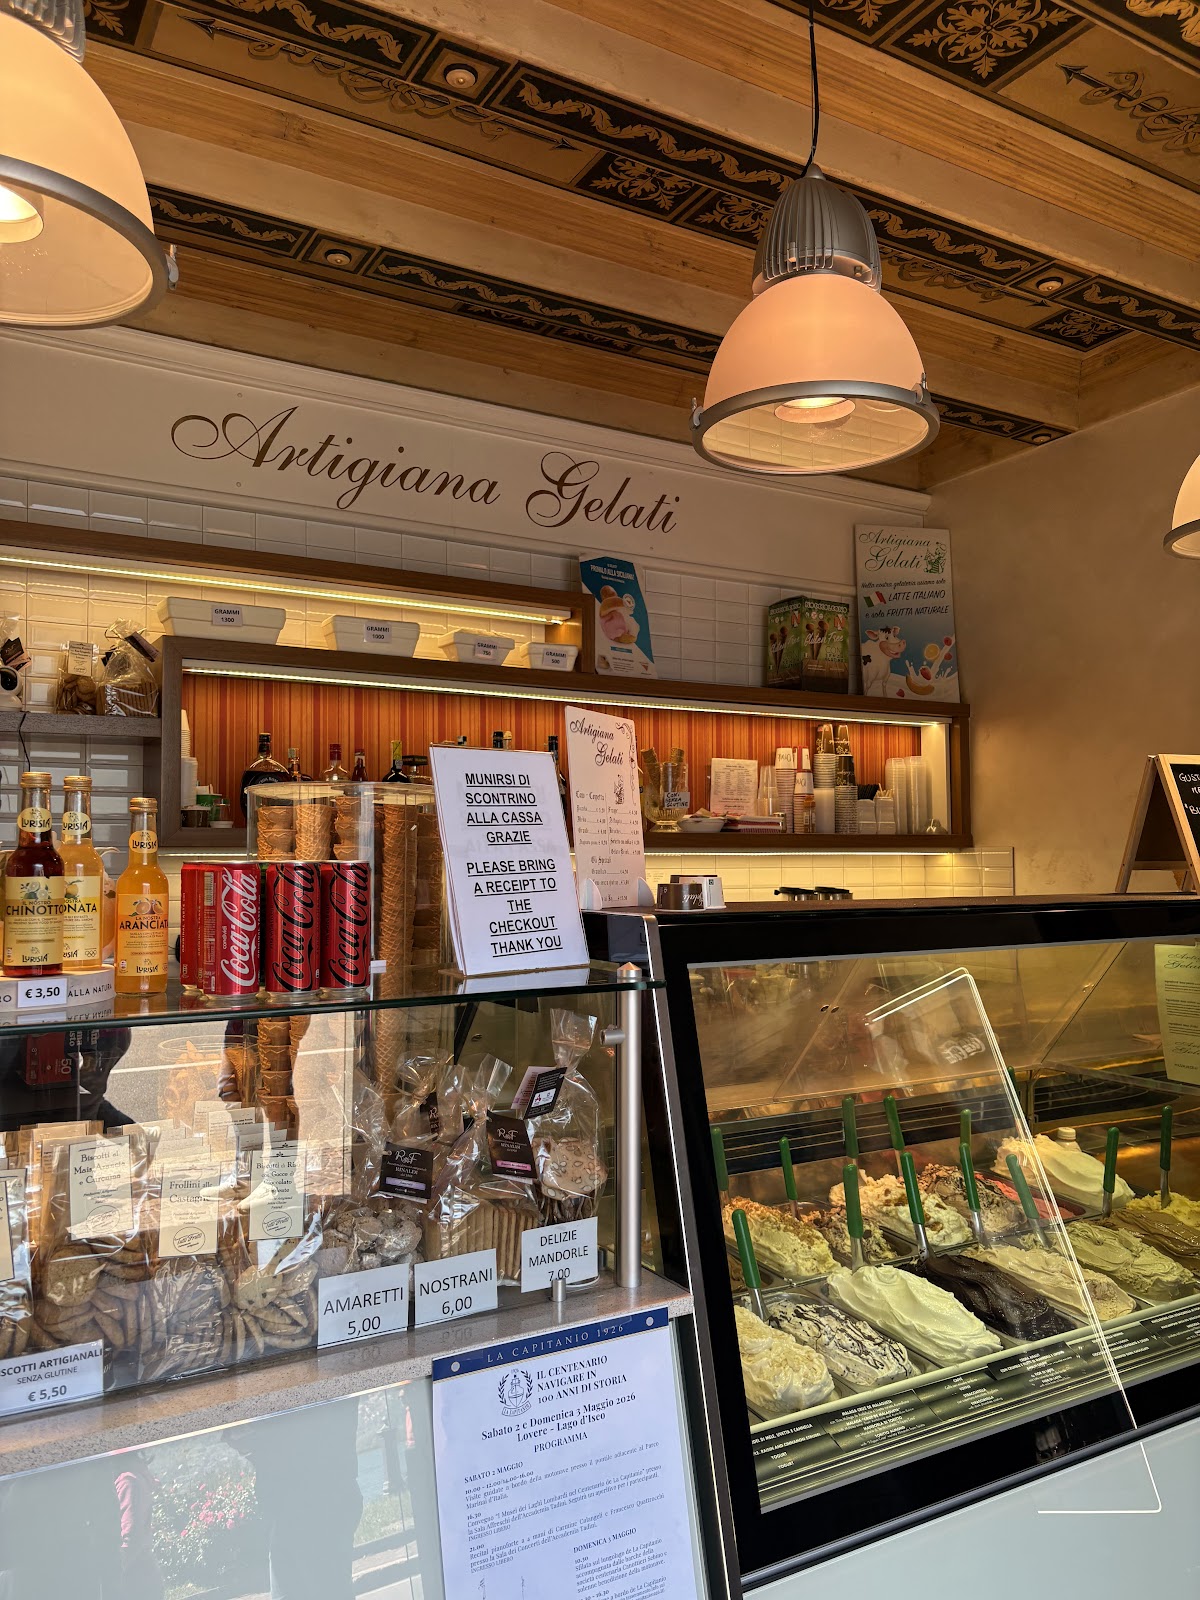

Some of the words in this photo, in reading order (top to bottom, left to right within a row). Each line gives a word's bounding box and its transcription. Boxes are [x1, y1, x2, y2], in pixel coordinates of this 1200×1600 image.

[170, 405, 501, 510] Artigiana
[525, 451, 680, 534] Gelati
[859, 529, 933, 552] Artigiana
[865, 545, 923, 572] Gelati
[889, 591, 912, 603] LATTE
[913, 589, 946, 601] ITALIANO
[214, 608, 240, 617] GRAMMI
[220, 616, 235, 624] 1300
[871, 609, 885, 618] solo
[887, 607, 913, 617] FRUTTA
[915, 605, 949, 617] NATURALE
[366, 625, 390, 634] GRAMMI
[371, 633, 385, 641] 1000
[477, 642, 498, 650] GRAMMI
[545, 651, 567, 659] GRAMMI
[569, 717, 615, 744] Artigiana
[594, 741, 624, 767] Gelati
[465, 773, 516, 787] MUNIRSI
[518, 774, 531, 787] DI
[465, 793, 537, 806] SCONTRINO
[21, 817, 51, 829] LURISIA
[467, 811, 500, 825] ALLA
[501, 811, 543, 824] CASSA
[132, 840, 157, 850] LURISIA
[486, 830, 533, 845] GRAZIE
[466, 861, 515, 876] PLEASE
[518, 858, 557, 873] BRING
[474, 881, 484, 895] A
[486, 879, 537, 894] RECEIPT
[538, 877, 557, 891] TO
[6, 903, 64, 916] CHINOTTO
[507, 898, 533, 913] THE
[119, 919, 169, 930] ARANCIAT
[489, 916, 556, 935] CHECKOUT
[490, 937, 536, 956] THANK
[536, 935, 563, 951] YOU
[22, 954, 48, 964] LURISIA
[25, 988, 33, 999] €
[35, 986, 60, 999] 3,50
[81, 1152, 110, 1163] Biscotti
[85, 1173, 121, 1184] Curcuma
[169, 1180, 201, 1189] Frollini
[540, 1229, 578, 1247] DELIZIE
[528, 1245, 589, 1268] MANDORLE
[419, 1267, 494, 1297] NOSTRANI
[323, 1287, 404, 1316] AMARETTI
[442, 1295, 473, 1317] 6,00
[347, 1315, 382, 1337] 5,00
[487, 1353, 504, 1363] LA
[512, 1331, 589, 1357] CAPITANIO
[597, 1325, 624, 1338] 1926
[0, 1360, 37, 1378] SCOTTI
[37, 1348, 103, 1374] ARTIGIANALI
[536, 1370, 548, 1380] IL
[548, 1355, 608, 1378] CENTENARIO
[17, 1372, 43, 1386] SENZA
[44, 1365, 78, 1381] GLUTINE
[537, 1373, 582, 1392] NAVIGARE
[583, 1369, 597, 1382] IN
[28, 1391, 36, 1403] €
[39, 1384, 68, 1402] 5,50
[538, 1394, 554, 1404] 100
[556, 1385, 579, 1400] ANNI
[581, 1382, 592, 1393] DI
[593, 1374, 628, 1391] STORIA
[481, 1426, 513, 1442] Sabato
[515, 1424, 521, 1432] 2
[522, 1421, 528, 1429] e
[530, 1410, 574, 1428] Domenica
[576, 1408, 581, 1418] 3
[583, 1399, 614, 1415] Maggio
[616, 1392, 636, 1405] 2026
[517, 1426, 548, 1443] Lovere
[557, 1419, 579, 1433] Lago
[580, 1411, 606, 1426] d'Iseo
[533, 1431, 588, 1453] PROGRAMMA
[770, 1451, 788, 1460] YOGURT
[464, 1470, 491, 1484] SABATO
[496, 1461, 524, 1475] MAGGIO
[777, 1460, 795, 1470] YOGURT
[465, 1486, 481, 1495] 10.00
[573, 1536, 608, 1554] DOMENICA
[612, 1527, 638, 1542] MAGGIO
[469, 1548, 489, 1561] Recital
[491, 1540, 519, 1555] pianoforte
